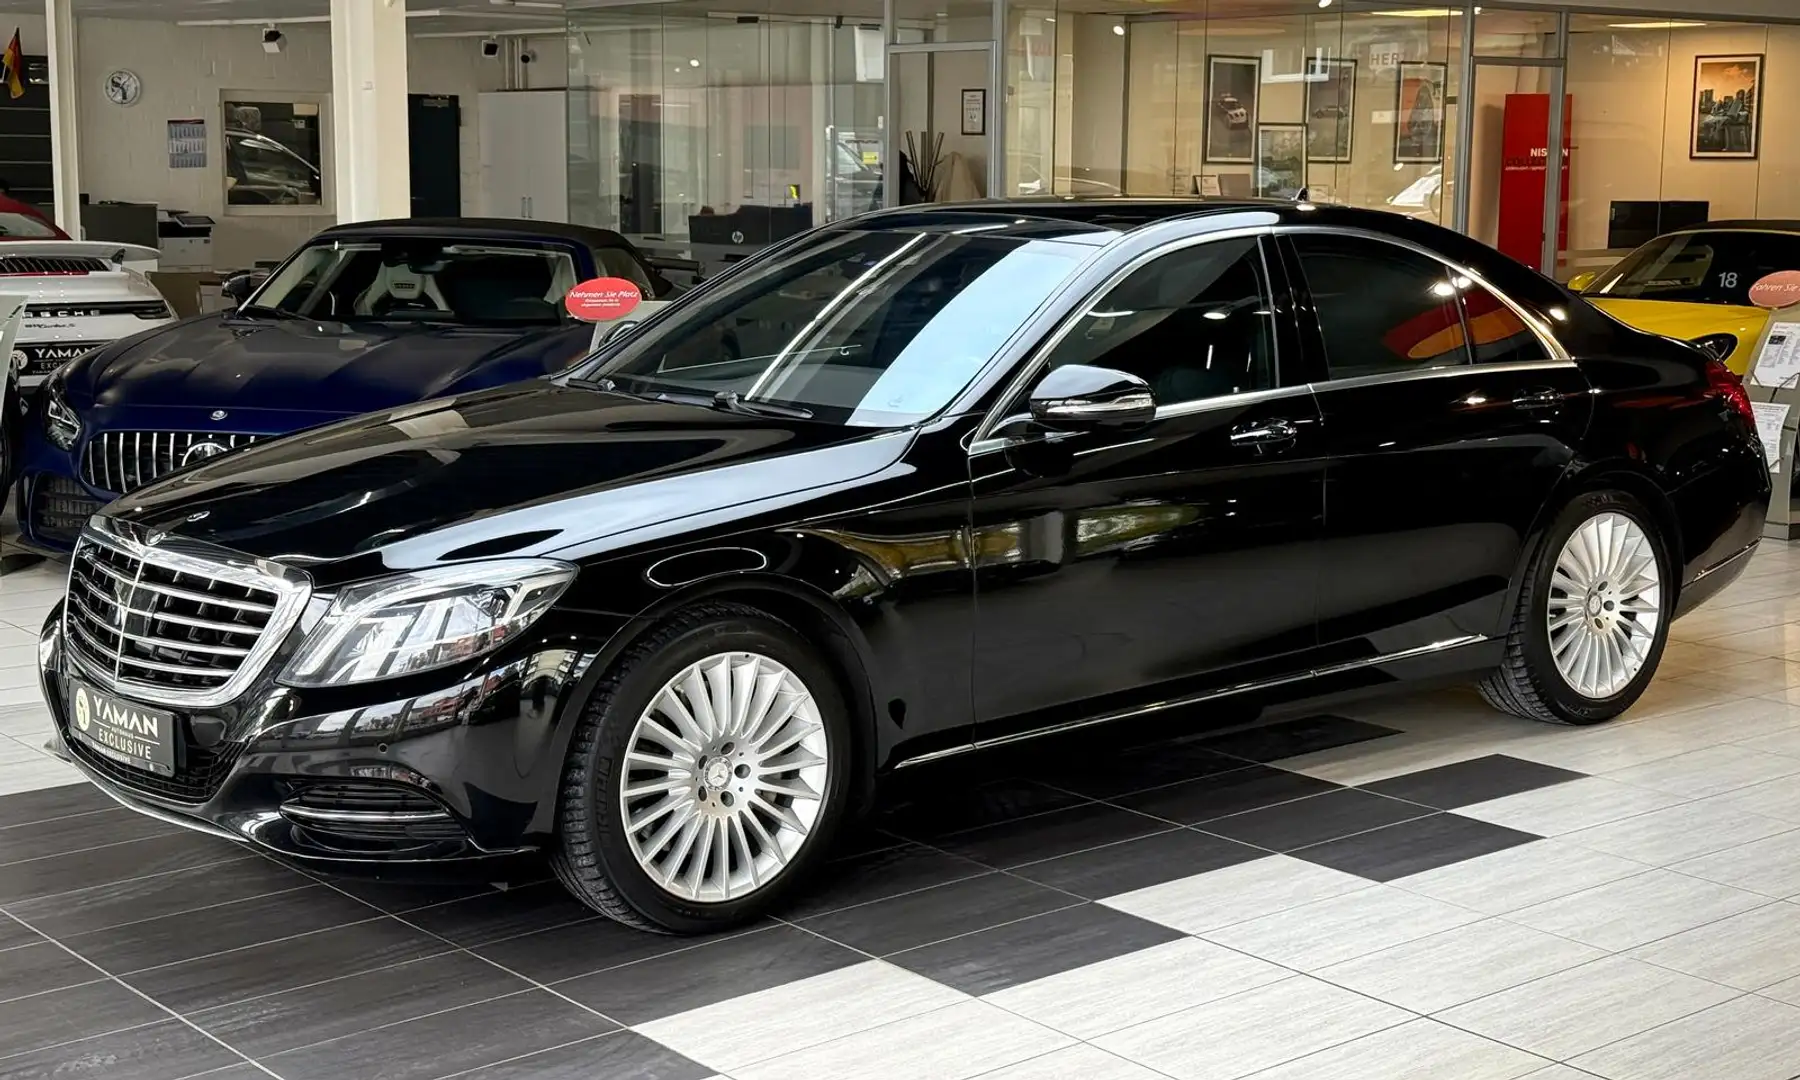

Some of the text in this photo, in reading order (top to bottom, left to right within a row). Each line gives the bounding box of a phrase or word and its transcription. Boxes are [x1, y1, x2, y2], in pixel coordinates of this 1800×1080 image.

[1530, 148, 1568, 157] NISN
[1718, 272, 1738, 288] 18
[618, 290, 639, 298] Platz
[93, 695, 158, 737] YAMAN
[98, 728, 151, 760] EXCLUSIVE
